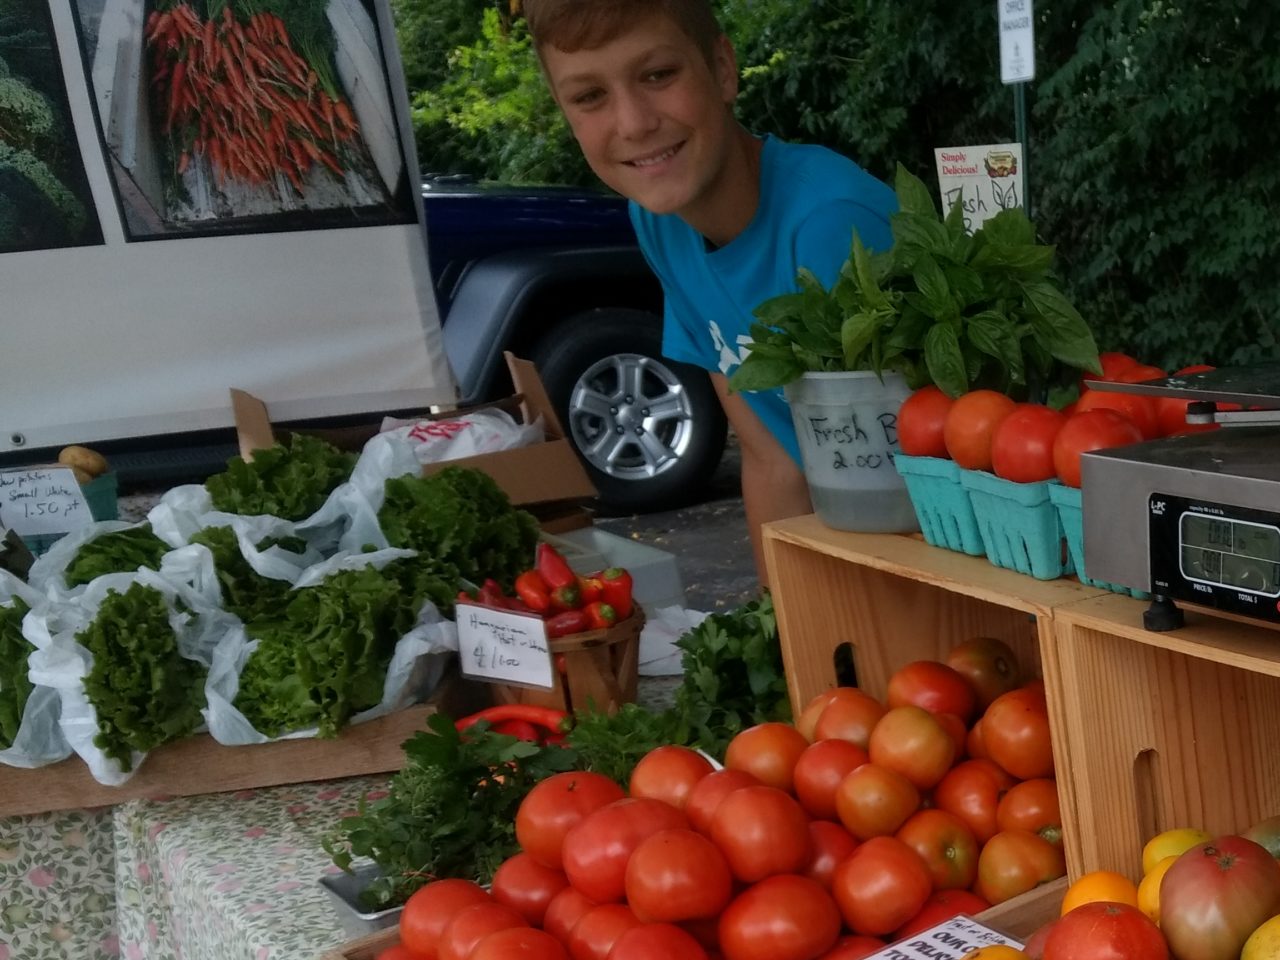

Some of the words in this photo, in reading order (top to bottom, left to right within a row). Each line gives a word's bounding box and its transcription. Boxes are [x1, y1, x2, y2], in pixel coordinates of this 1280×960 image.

[941, 151, 967, 162] Simply
[942, 164, 978, 175] Delicious!
[944, 184, 988, 213] Fesh
[808, 412, 869, 446] Fresh
[833, 451, 882, 470] 2.00
[9, 487, 37, 501] Small
[25, 501, 59, 518] 1.50
[64, 499, 79, 517] pt
[1151, 500, 1166, 511] L-PC
[1238, 593, 1253, 603] TOTAL
[932, 931, 968, 949] OUR
